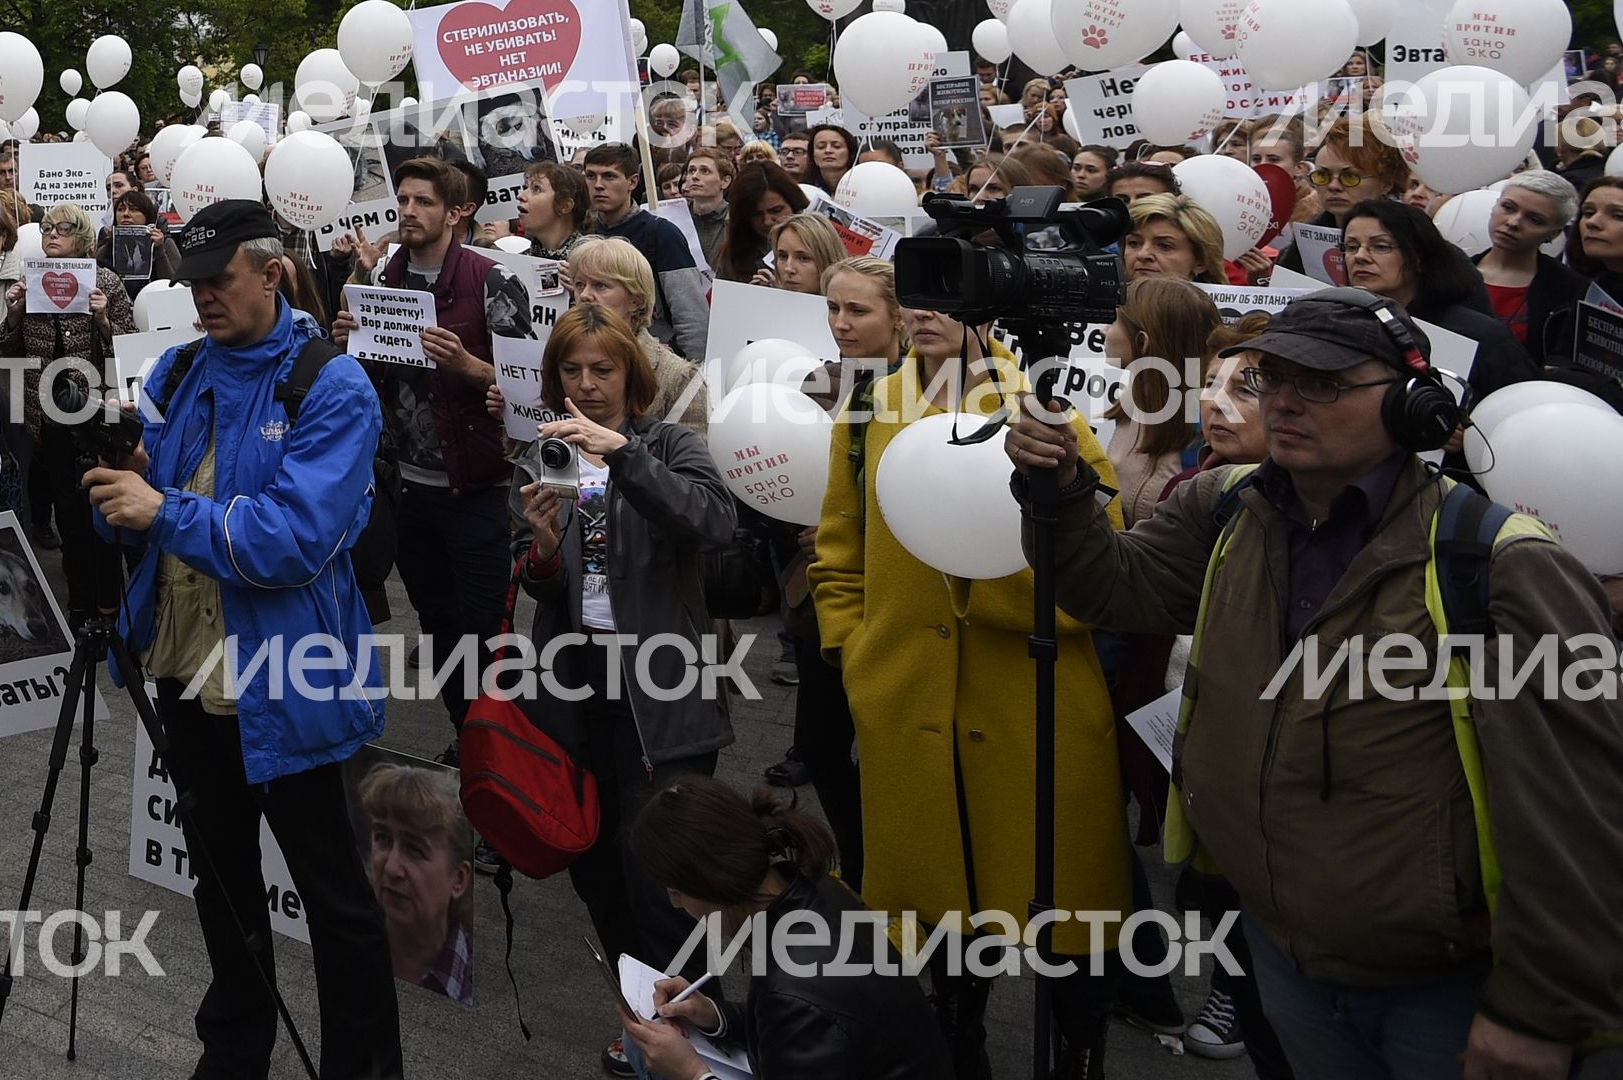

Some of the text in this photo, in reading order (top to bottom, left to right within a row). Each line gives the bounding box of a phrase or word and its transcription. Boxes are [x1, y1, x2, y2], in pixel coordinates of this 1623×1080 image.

[1087, 1, 1125, 20] ХОТИМ
[1472, 12, 1497, 22] МЫ
[443, 11, 570, 43] СТЕРИЛИЗОВАТЬ,
[1083, 10, 1121, 29] ЖИТЬ!
[1456, 24, 1516, 36] ПРОТИВ
[465, 29, 557, 56] НЕ УБИВАТЬ!
[499, 51, 527, 67] НЕТ
[1392, 45, 1445, 62] Эвта
[1467, 48, 1501, 60] ЭКО
[471, 62, 562, 88] ЭВТАНАЗИИ!
[1225, 83, 1252, 92] ОР
[1093, 105, 1132, 119] чер
[39, 169, 83, 178] Бано Эко
[34, 182, 47, 190] Ад
[64, 180, 97, 189] земле!
[196, 184, 215, 193] МЫ
[35, 192, 96, 202] Петросьян к
[277, 195, 323, 212] ПРОТИВ
[289, 191, 310, 201] МЫ
[1300, 229, 1312, 240] НЕТ
[35, 261, 55, 269] ЗАКОНУ
[55, 261, 62, 269] ОБ
[1239, 294, 1250, 304] ОБ
[359, 304, 424, 320] за решетку!
[361, 317, 424, 333] Вор должен
[1587, 316, 1623, 338] БЕСПРАВ
[373, 335, 412, 348] сидеть
[500, 363, 526, 381] НЕТ
[734, 445, 761, 461] МЫ
[726, 453, 789, 480] ПРОТИВ
[756, 487, 794, 505] ЭКО
